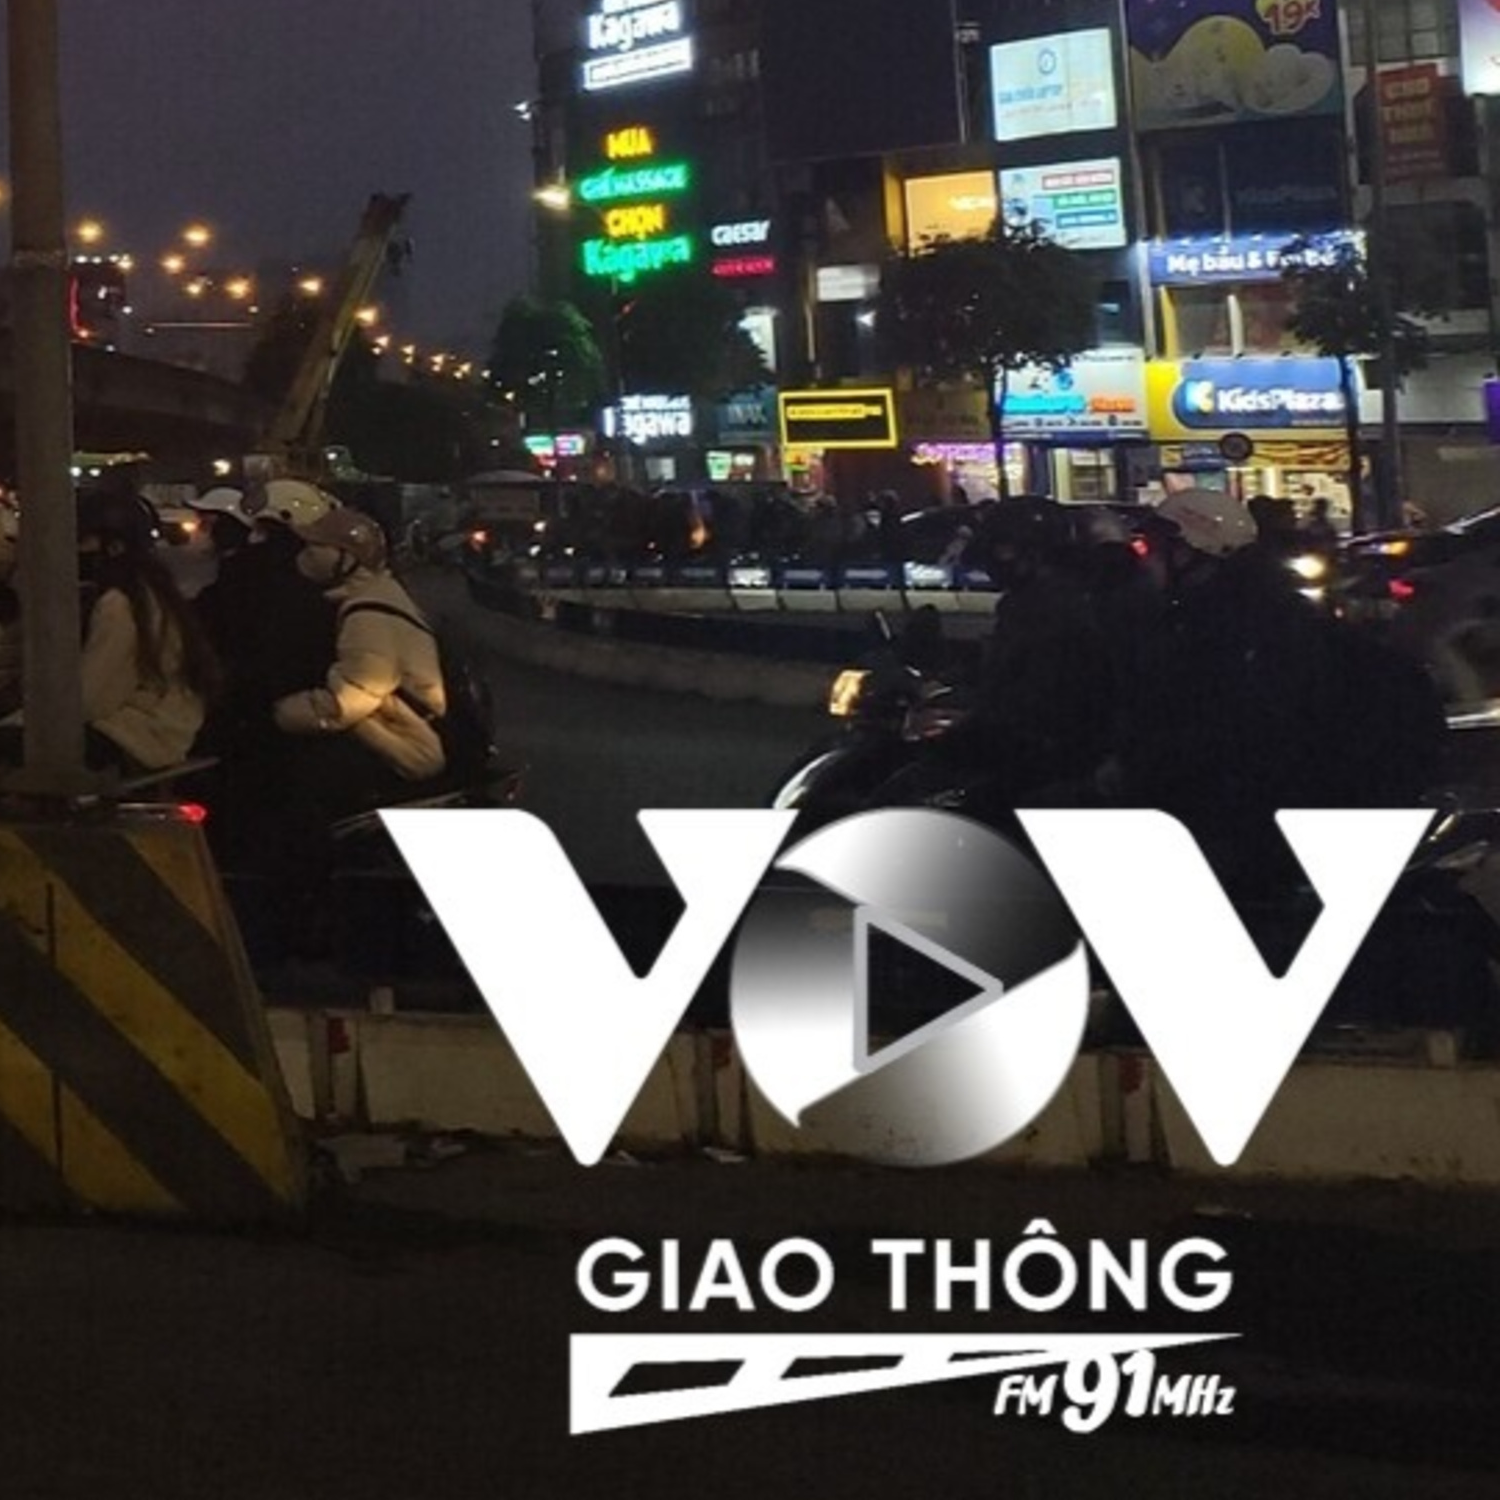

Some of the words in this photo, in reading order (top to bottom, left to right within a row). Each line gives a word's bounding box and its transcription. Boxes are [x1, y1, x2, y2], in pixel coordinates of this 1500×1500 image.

[589, 2, 680, 51] Kagawa
[607, 127, 653, 159] MUA
[607, 204, 663, 240] CHỌN
[583, 237, 690, 282] Kagawa
[1167, 253, 1199, 276] Mẹ
[1202, 244, 1245, 269] bầu
[1247, 252, 1263, 268] &
